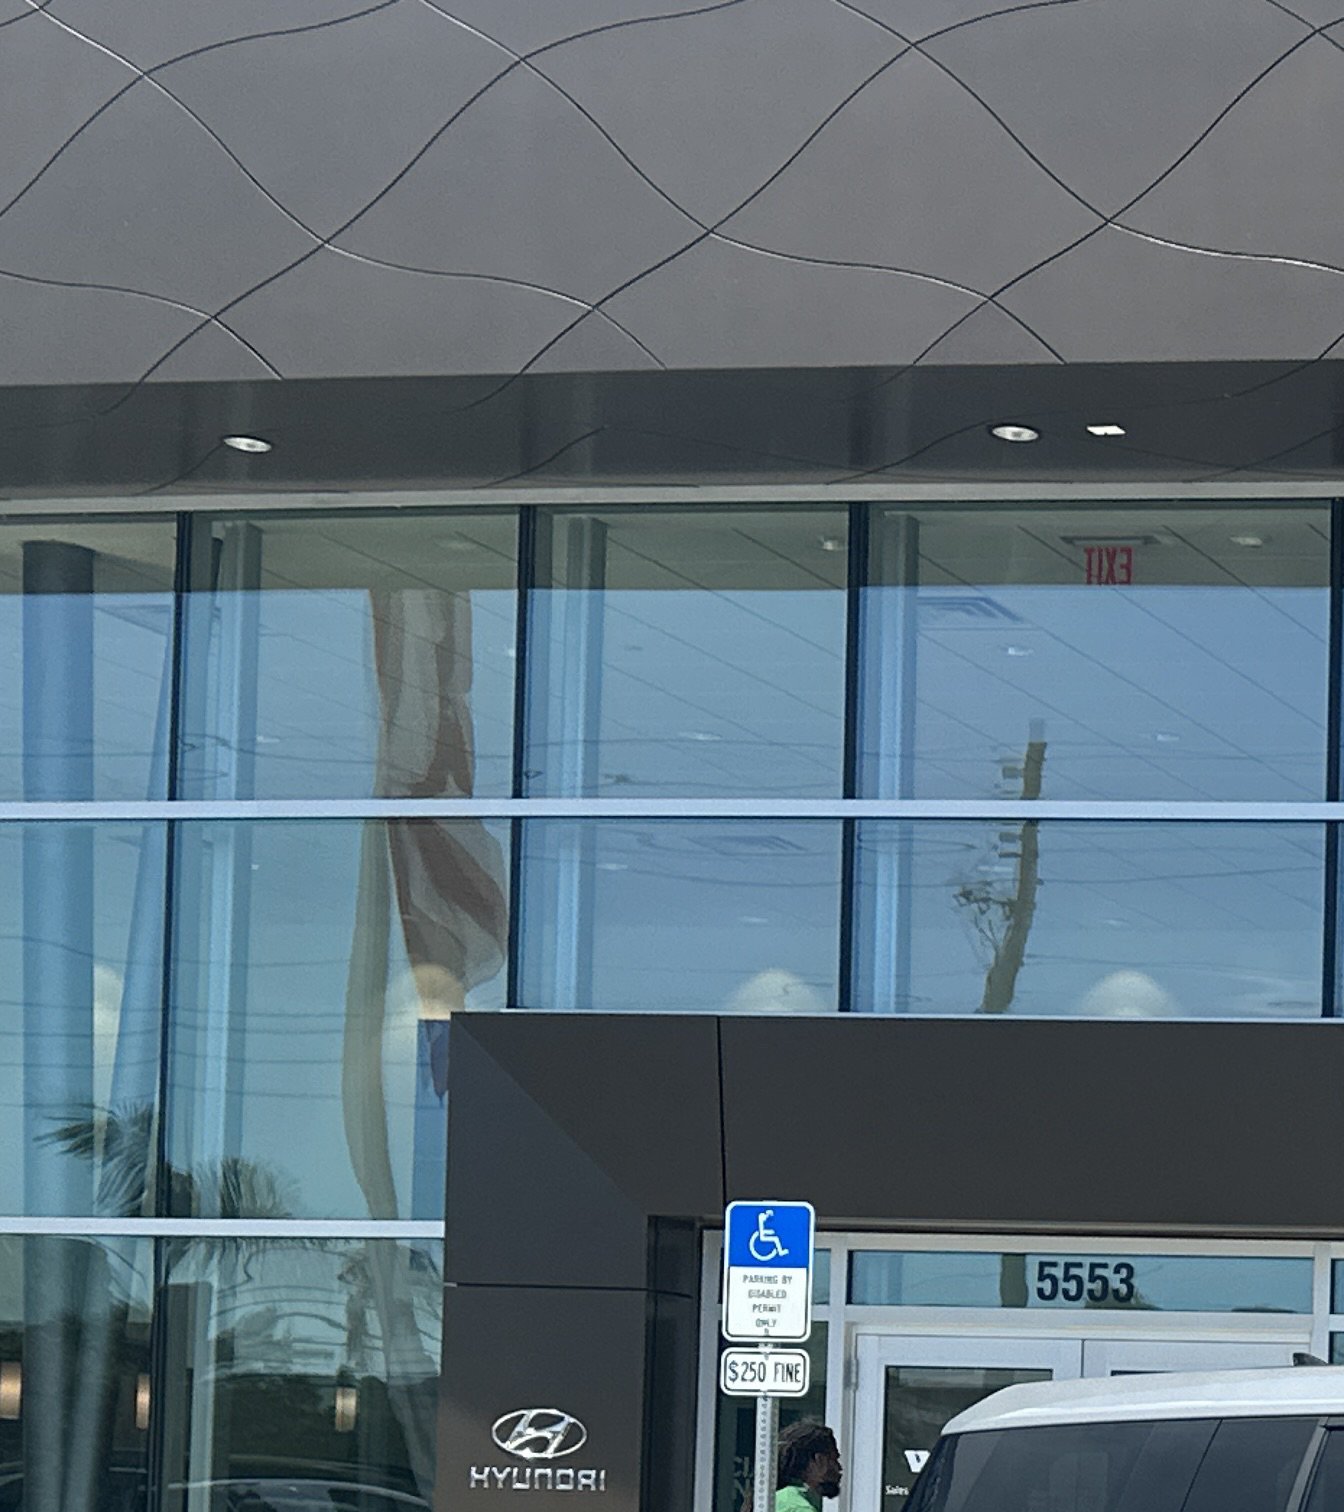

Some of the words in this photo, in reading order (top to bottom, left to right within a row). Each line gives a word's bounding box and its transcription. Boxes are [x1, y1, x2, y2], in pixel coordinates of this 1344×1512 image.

[742, 1274, 778, 1284] PARKING
[781, 1274, 792, 1284] BY
[1036, 1261, 1134, 1302] 5553
[748, 1289, 787, 1299] DISABLED
[728, 1360, 766, 1383] $250
[773, 1361, 801, 1383] FINE
[470, 1466, 606, 1491] HYUNDAI
